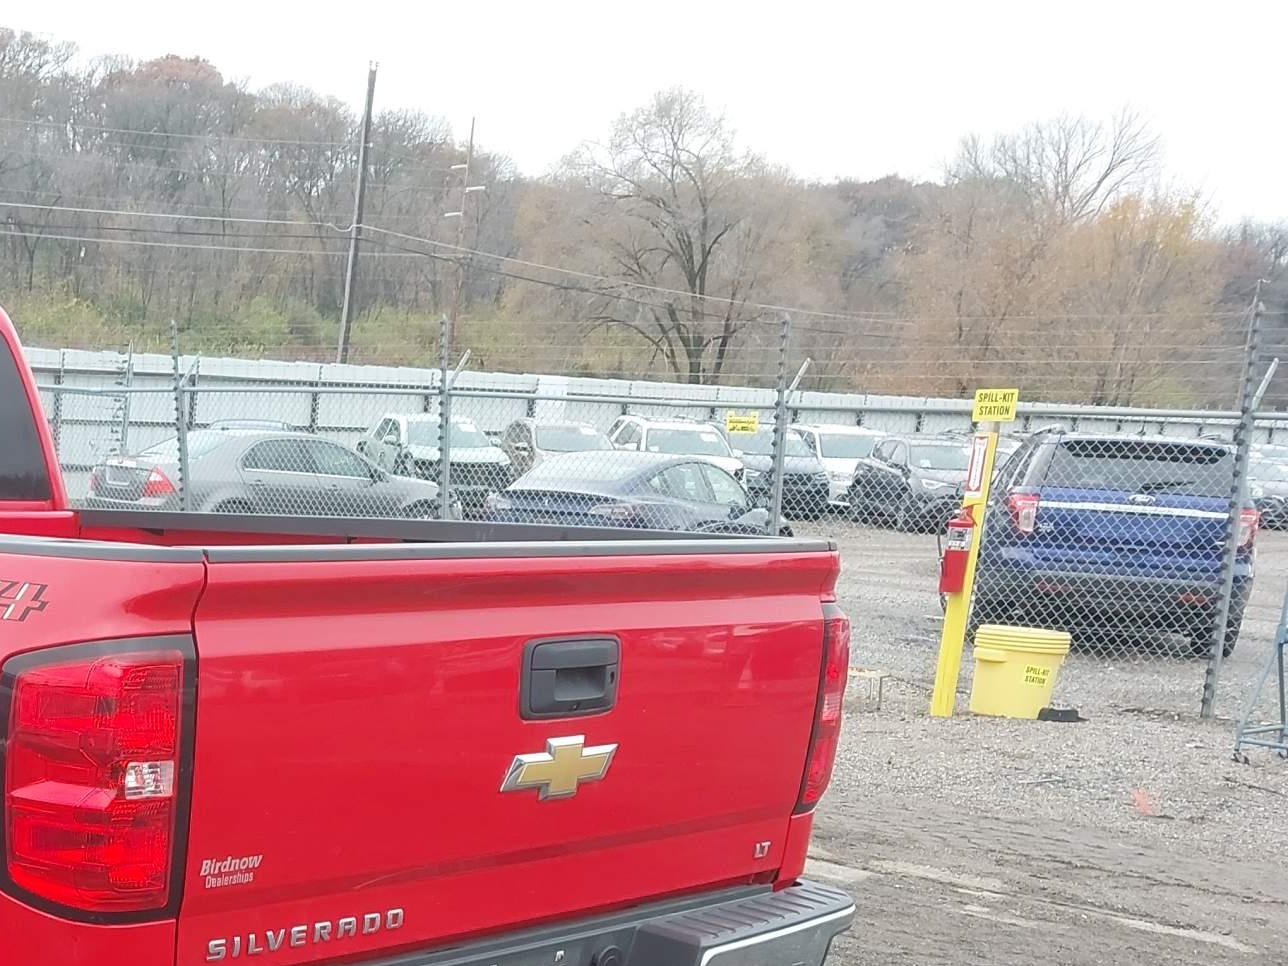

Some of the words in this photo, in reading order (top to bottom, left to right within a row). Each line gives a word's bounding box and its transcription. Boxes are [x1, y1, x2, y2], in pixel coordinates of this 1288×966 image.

[978, 392, 1015, 402] SPILL-KIT
[979, 405, 1011, 416] STATION
[1025, 666, 1050, 676] SPILL-KIT
[1024, 675, 1046, 685] STATION
[754, 841, 772, 858] LT
[200, 855, 263, 877] Birdnow
[205, 871, 254, 889] Dealerships
[206, 908, 405, 961] SILVERADO
